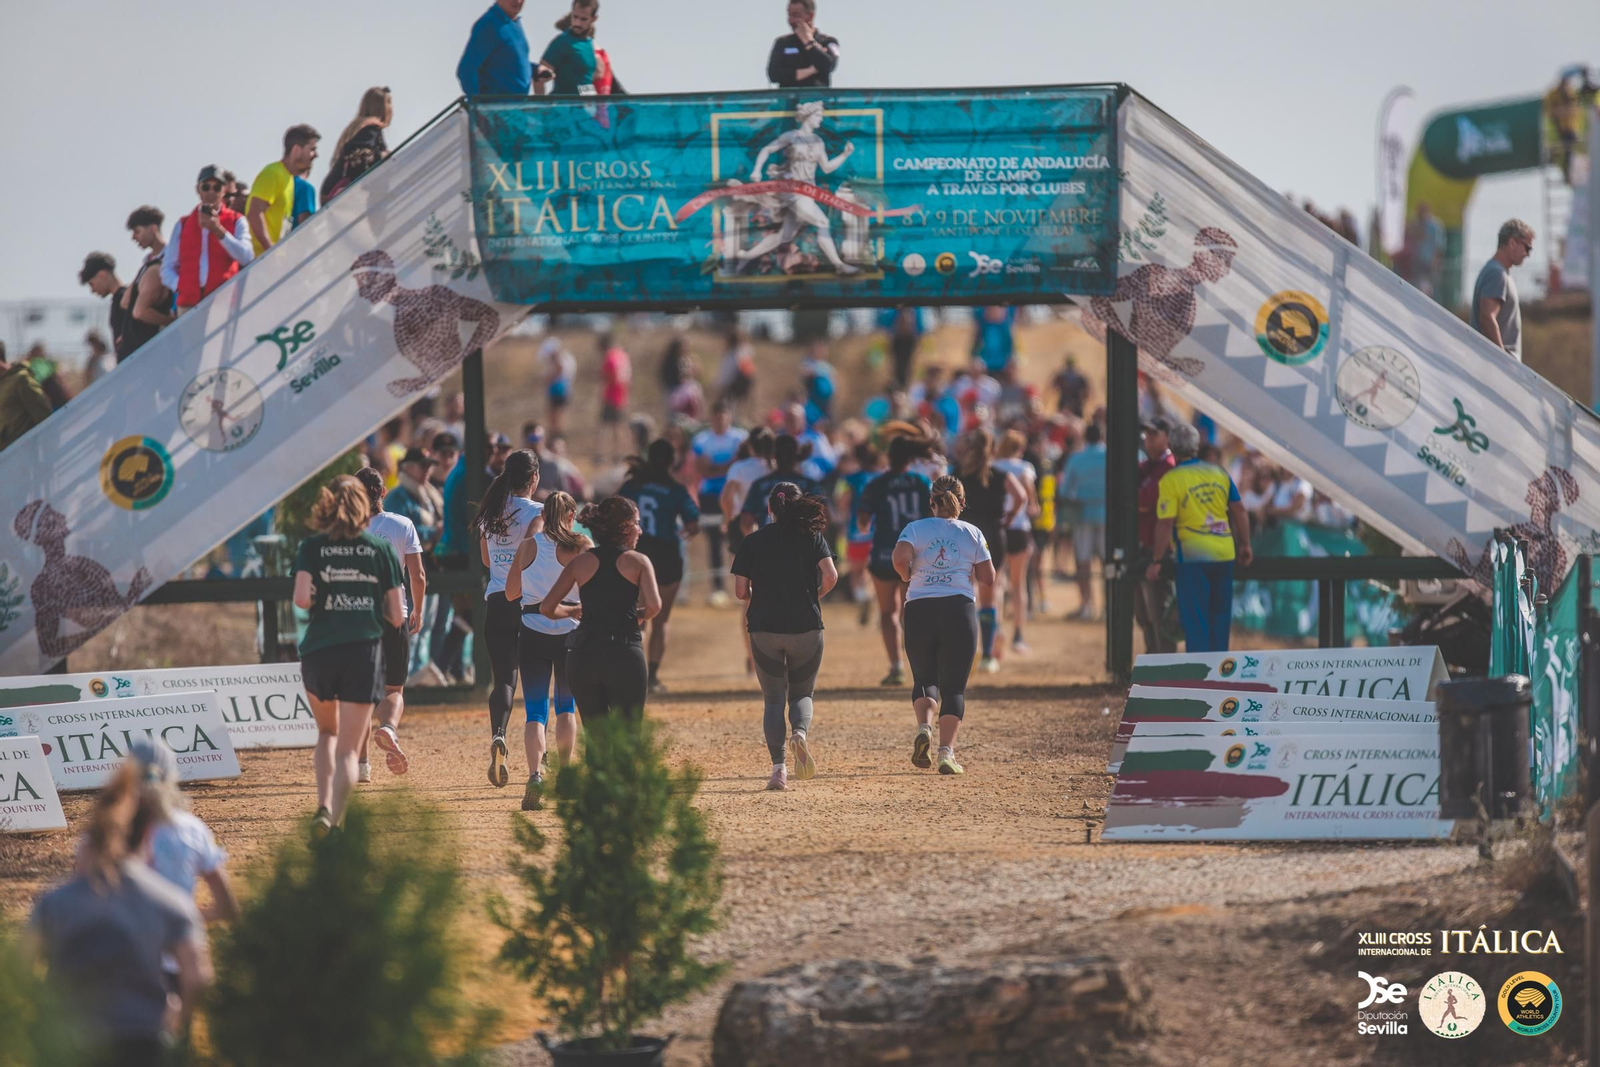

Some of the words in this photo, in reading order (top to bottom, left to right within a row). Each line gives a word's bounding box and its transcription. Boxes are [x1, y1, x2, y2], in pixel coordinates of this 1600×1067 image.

[893, 158, 997, 170] CAMPEONATO
[999, 157, 1019, 169] DE
[1022, 154, 1110, 169] ANDALUCÍA
[487, 160, 575, 191] XLIII
[577, 160, 651, 180] CROSS
[965, 171, 984, 182] DE
[985, 170, 1041, 181] CAMPO
[927, 185, 940, 195] A
[942, 181, 997, 195] TRAVÉS
[1000, 183, 1029, 195] POR
[1031, 182, 1086, 194] CLUBES
[486, 188, 679, 236] ITÁLICA
[902, 211, 912, 226] 8
[915, 210, 931, 225] Y
[936, 210, 947, 225] 9
[953, 210, 977, 226] DE
[984, 208, 1103, 226] NOVIEMBRE
[290, 353, 342, 394] Sevilla
[1417, 445, 1466, 487] Sevilla
[925, 574, 952, 583] 2025
[1286, 660, 1320, 670] CROSS
[1321, 658, 1405, 669] INTERNACIONAL
[1408, 657, 1423, 667] DE
[162, 679, 198, 689] CROSS
[200, 675, 290, 687] INTERNACIONAL
[292, 674, 303, 682] D
[47, 714, 87, 725] CROSS
[90, 706, 186, 721] INTERNACIONAL
[187, 703, 208, 713] DE
[1292, 706, 1328, 717] CROSS
[1330, 708, 1420, 723] INTERNACIONAL
[247, 724, 276, 733] CROSS
[13, 750, 31, 760] DE
[1303, 749, 1343, 760] CROSS
[63, 762, 126, 774] INTERNATIO
[176, 754, 223, 765] COUNTRY
[1283, 811, 1361, 820] INTERNATIONAL
[1362, 811, 1395, 819] CROSS
